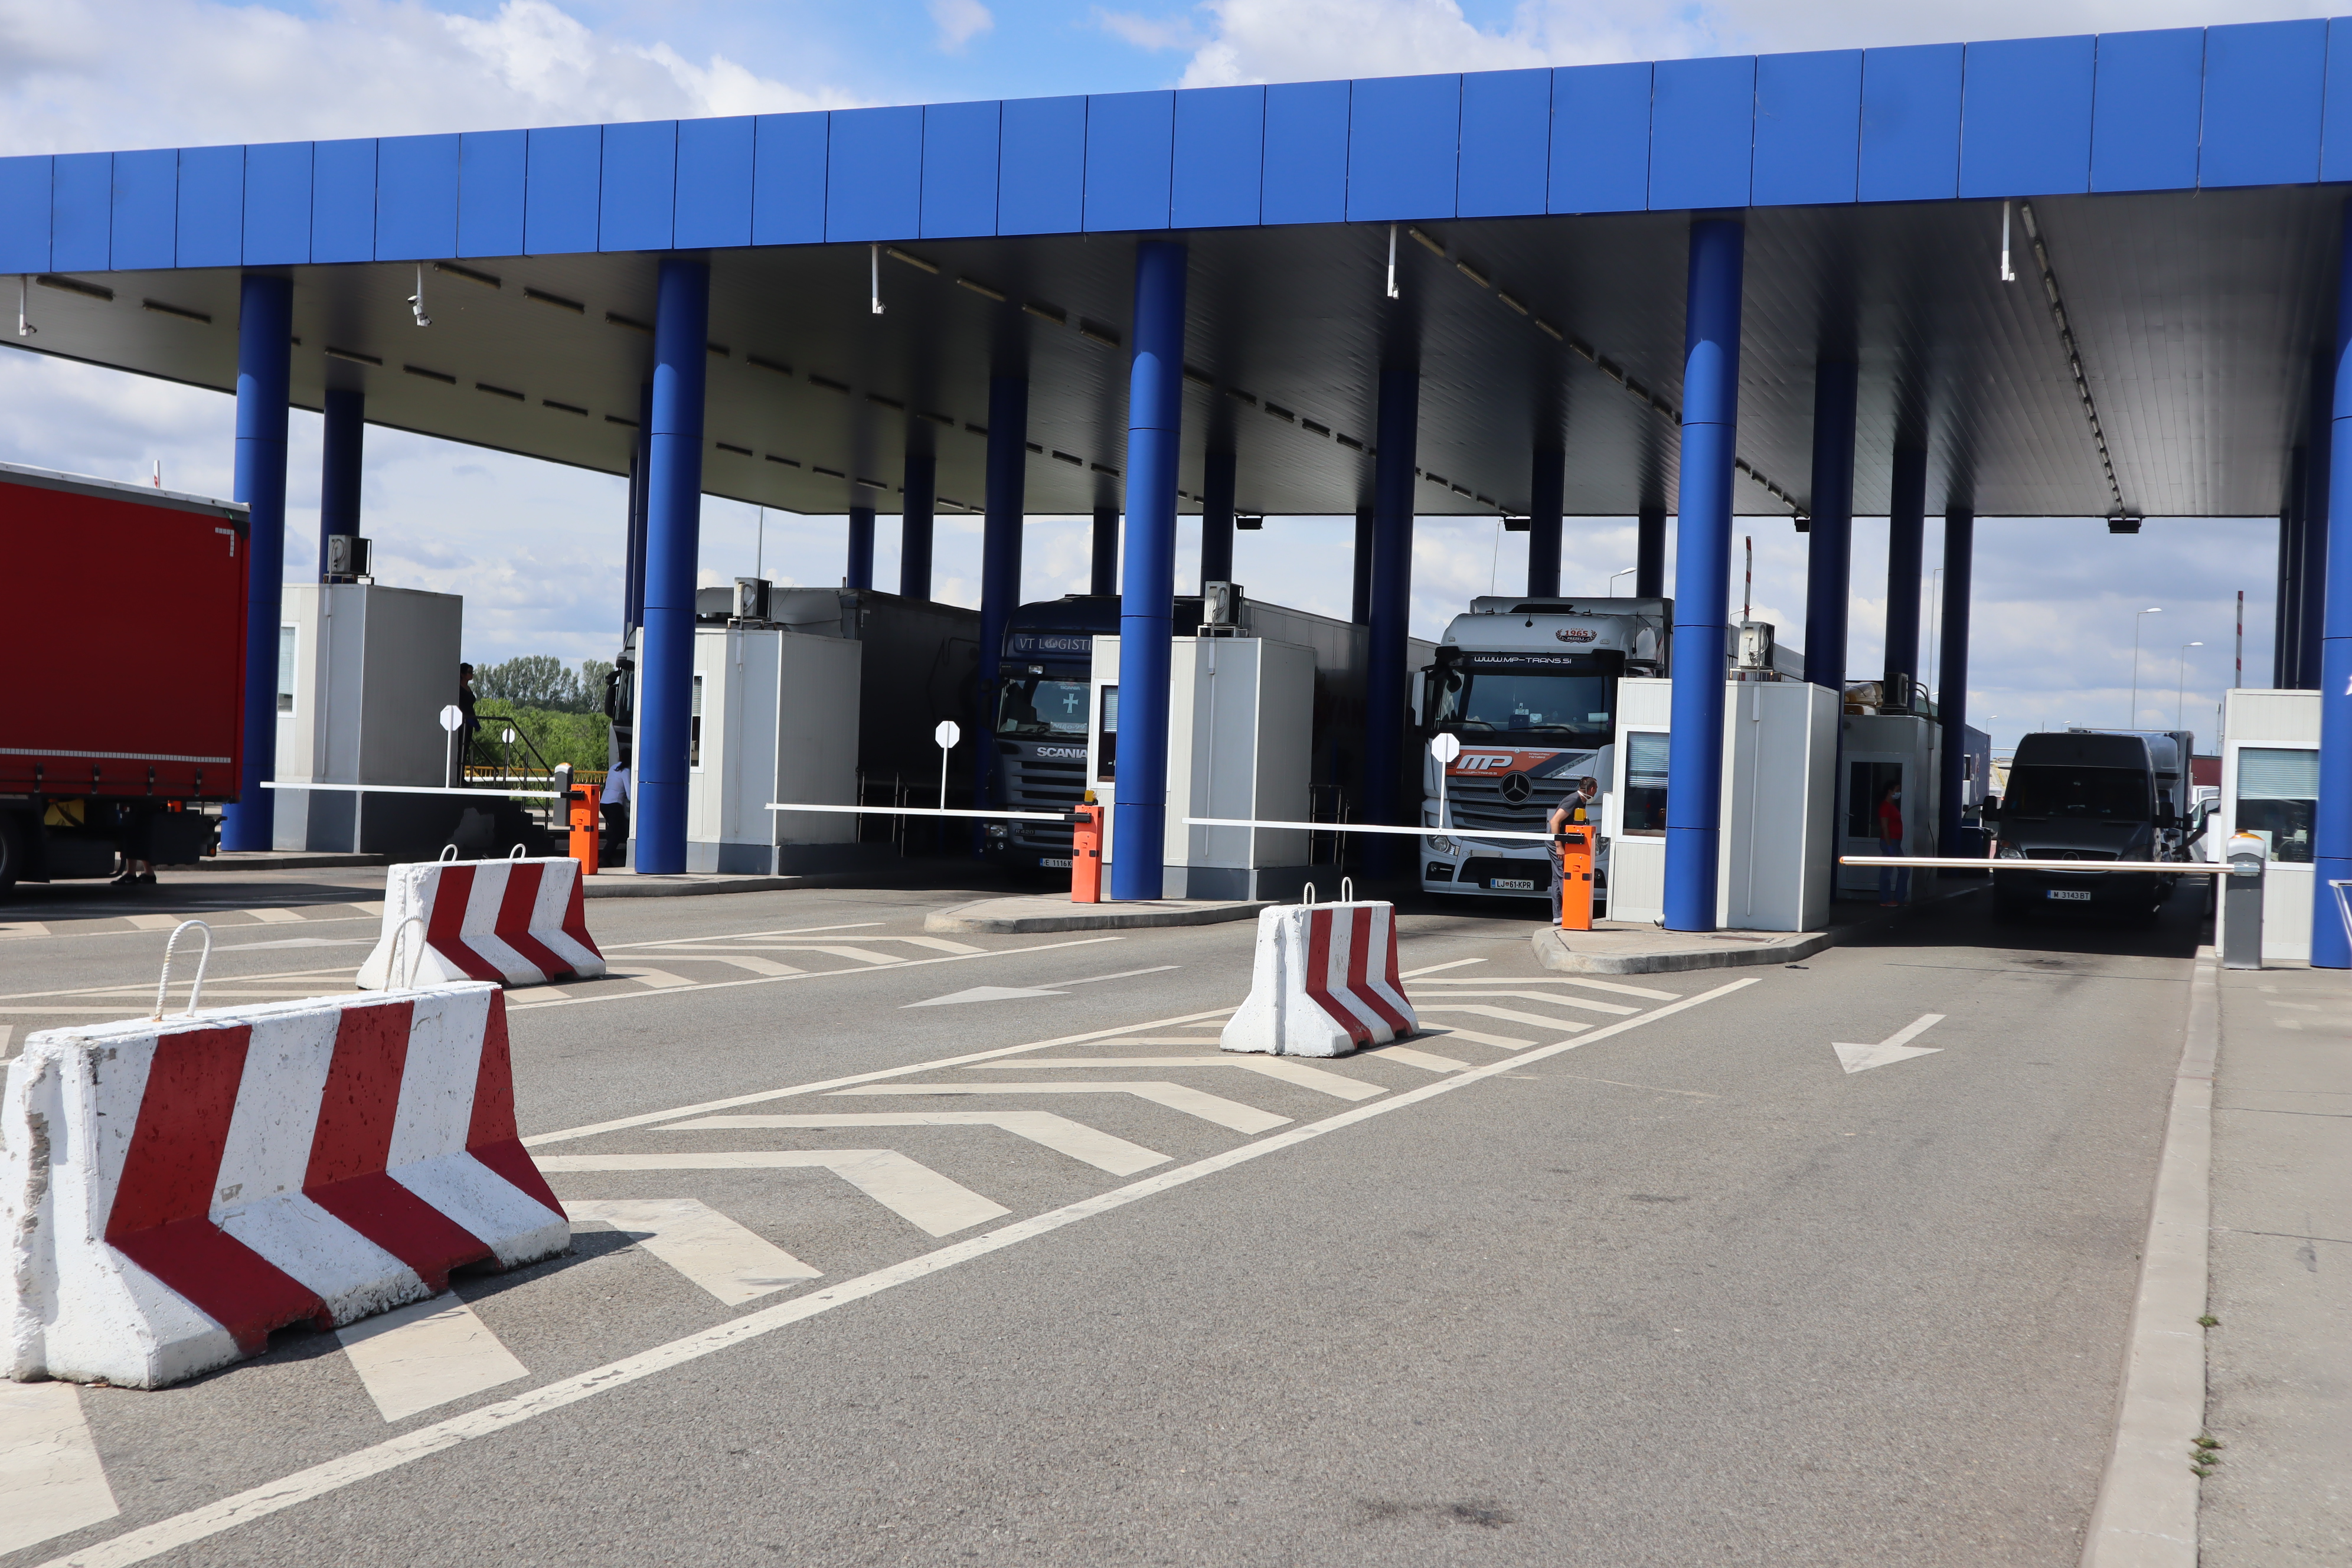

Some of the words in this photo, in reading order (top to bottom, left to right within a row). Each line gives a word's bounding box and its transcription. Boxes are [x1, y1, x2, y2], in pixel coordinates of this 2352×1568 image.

[1020, 638, 1035, 649] VT
[1038, 638, 1091, 650] LOGISTI
[1474, 656, 1572, 664] WWW.MP-TRANS.SI
[1037, 747, 1087, 759] SCANIA
[1456, 754, 1513, 770] MP
[1550, 767, 1566, 779] JUST
[1576, 753, 1593, 764] TIME
